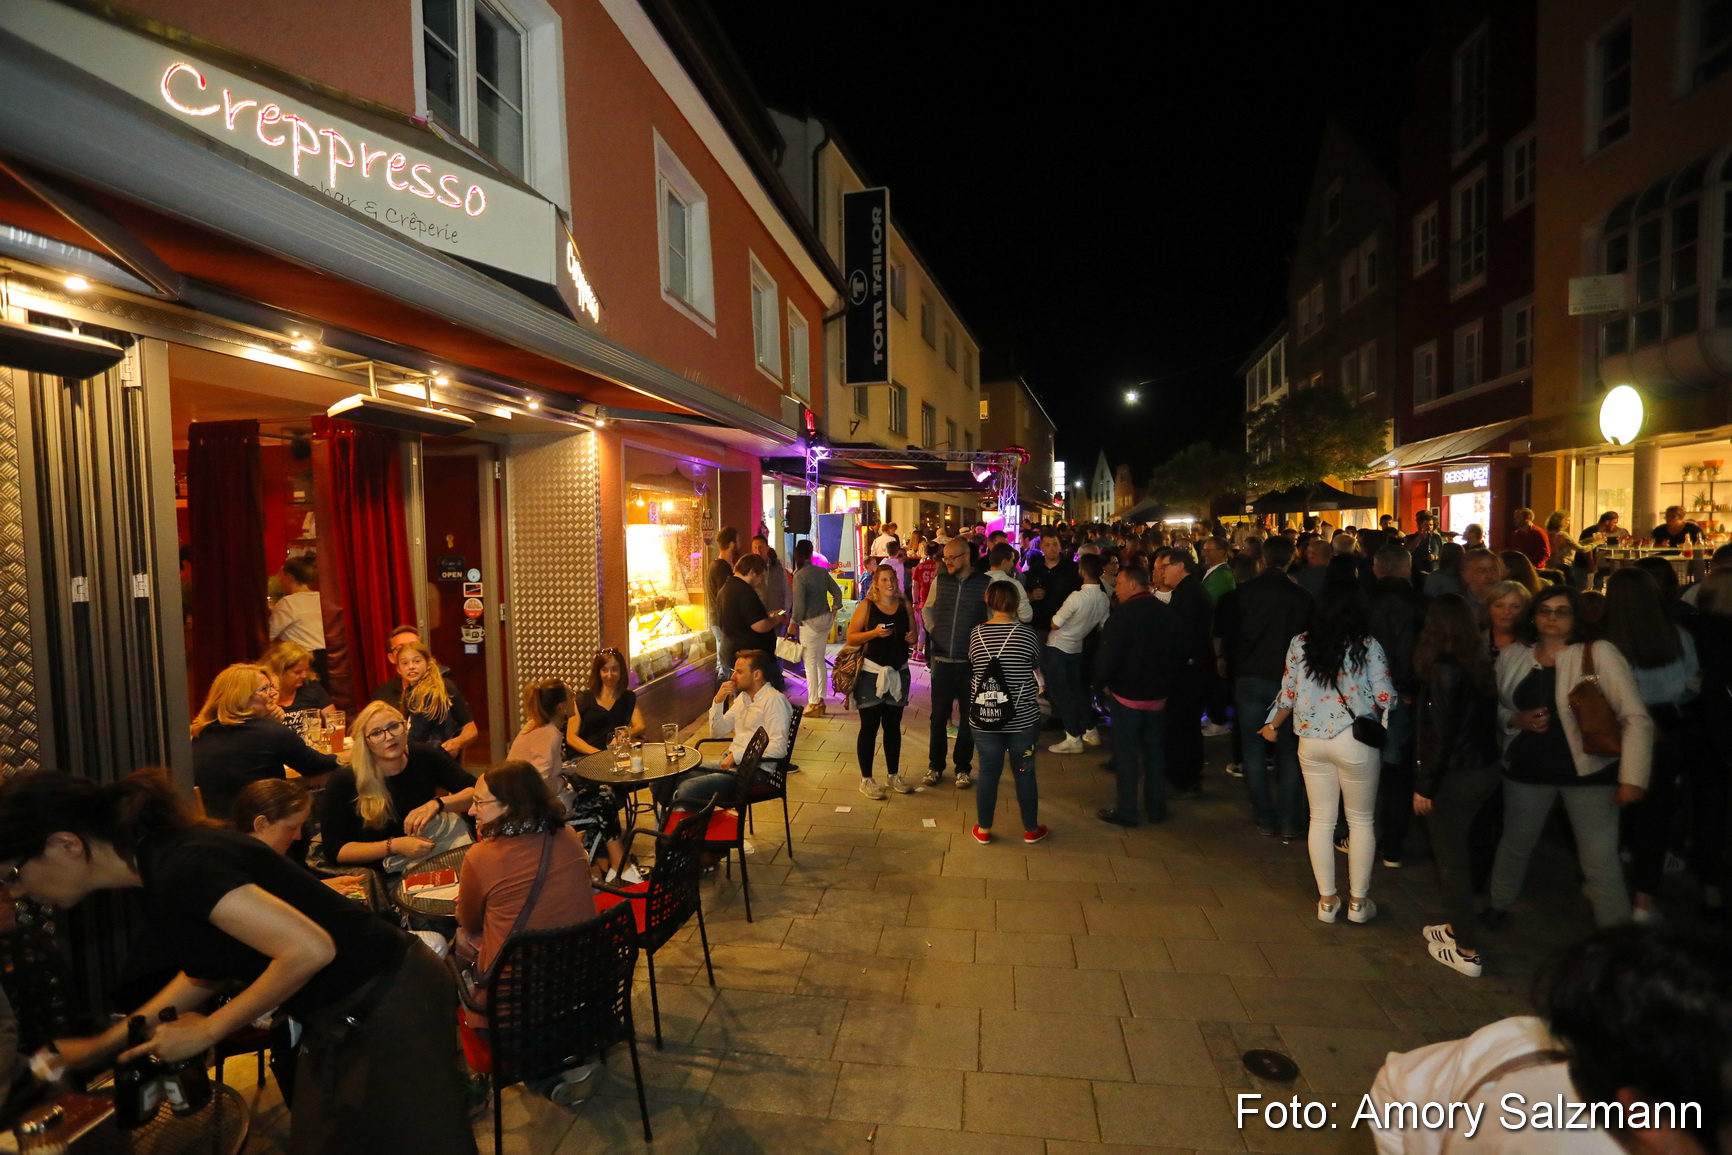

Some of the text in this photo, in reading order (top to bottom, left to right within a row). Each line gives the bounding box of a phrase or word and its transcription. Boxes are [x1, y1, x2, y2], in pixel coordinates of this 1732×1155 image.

[160, 62, 487, 216] Creppresso
[364, 201, 378, 222] &
[385, 207, 459, 244] Crêperie
[872, 206, 884, 365] TOM TAILOR
[1444, 467, 1488, 484] REISSINGER
